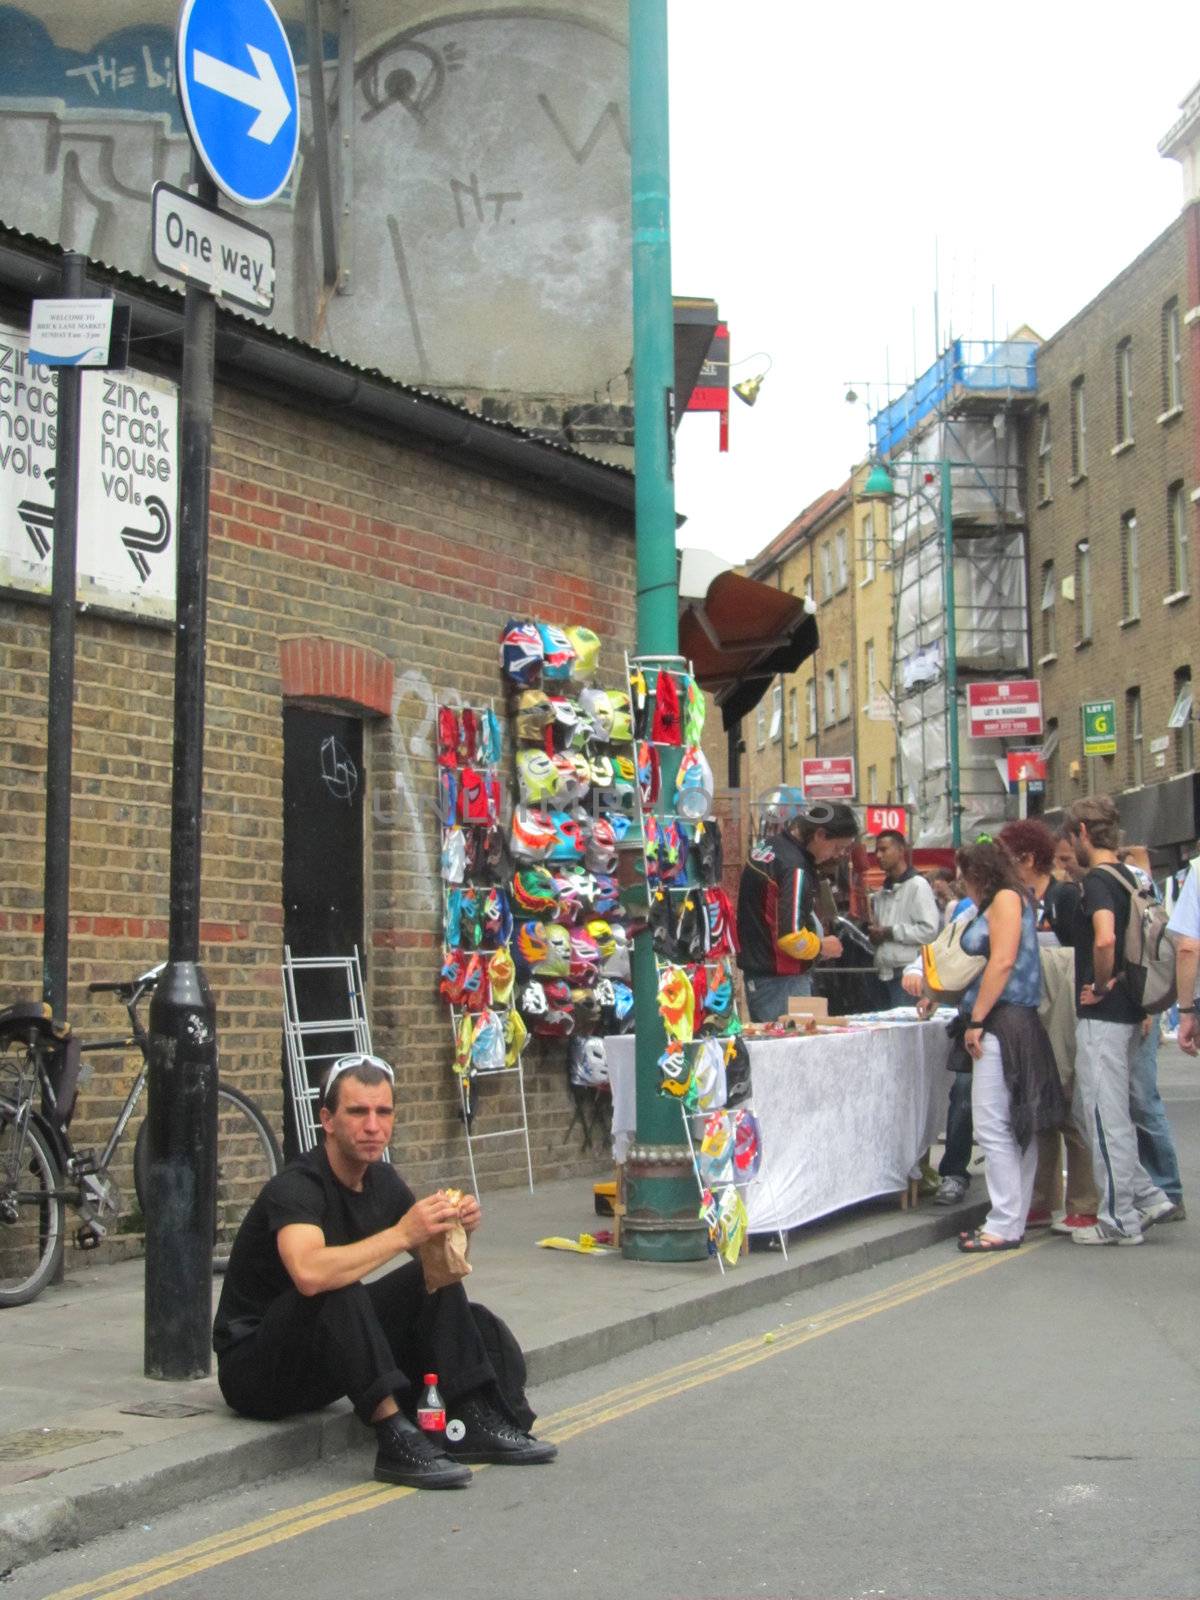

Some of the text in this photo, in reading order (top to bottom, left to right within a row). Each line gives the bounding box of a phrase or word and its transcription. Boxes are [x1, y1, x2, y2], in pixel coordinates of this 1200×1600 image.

[166, 211, 264, 291] One way
[0, 377, 58, 418] crac
[102, 410, 169, 452] crack
[101, 433, 170, 482] house
[873, 809, 899, 830] £10
